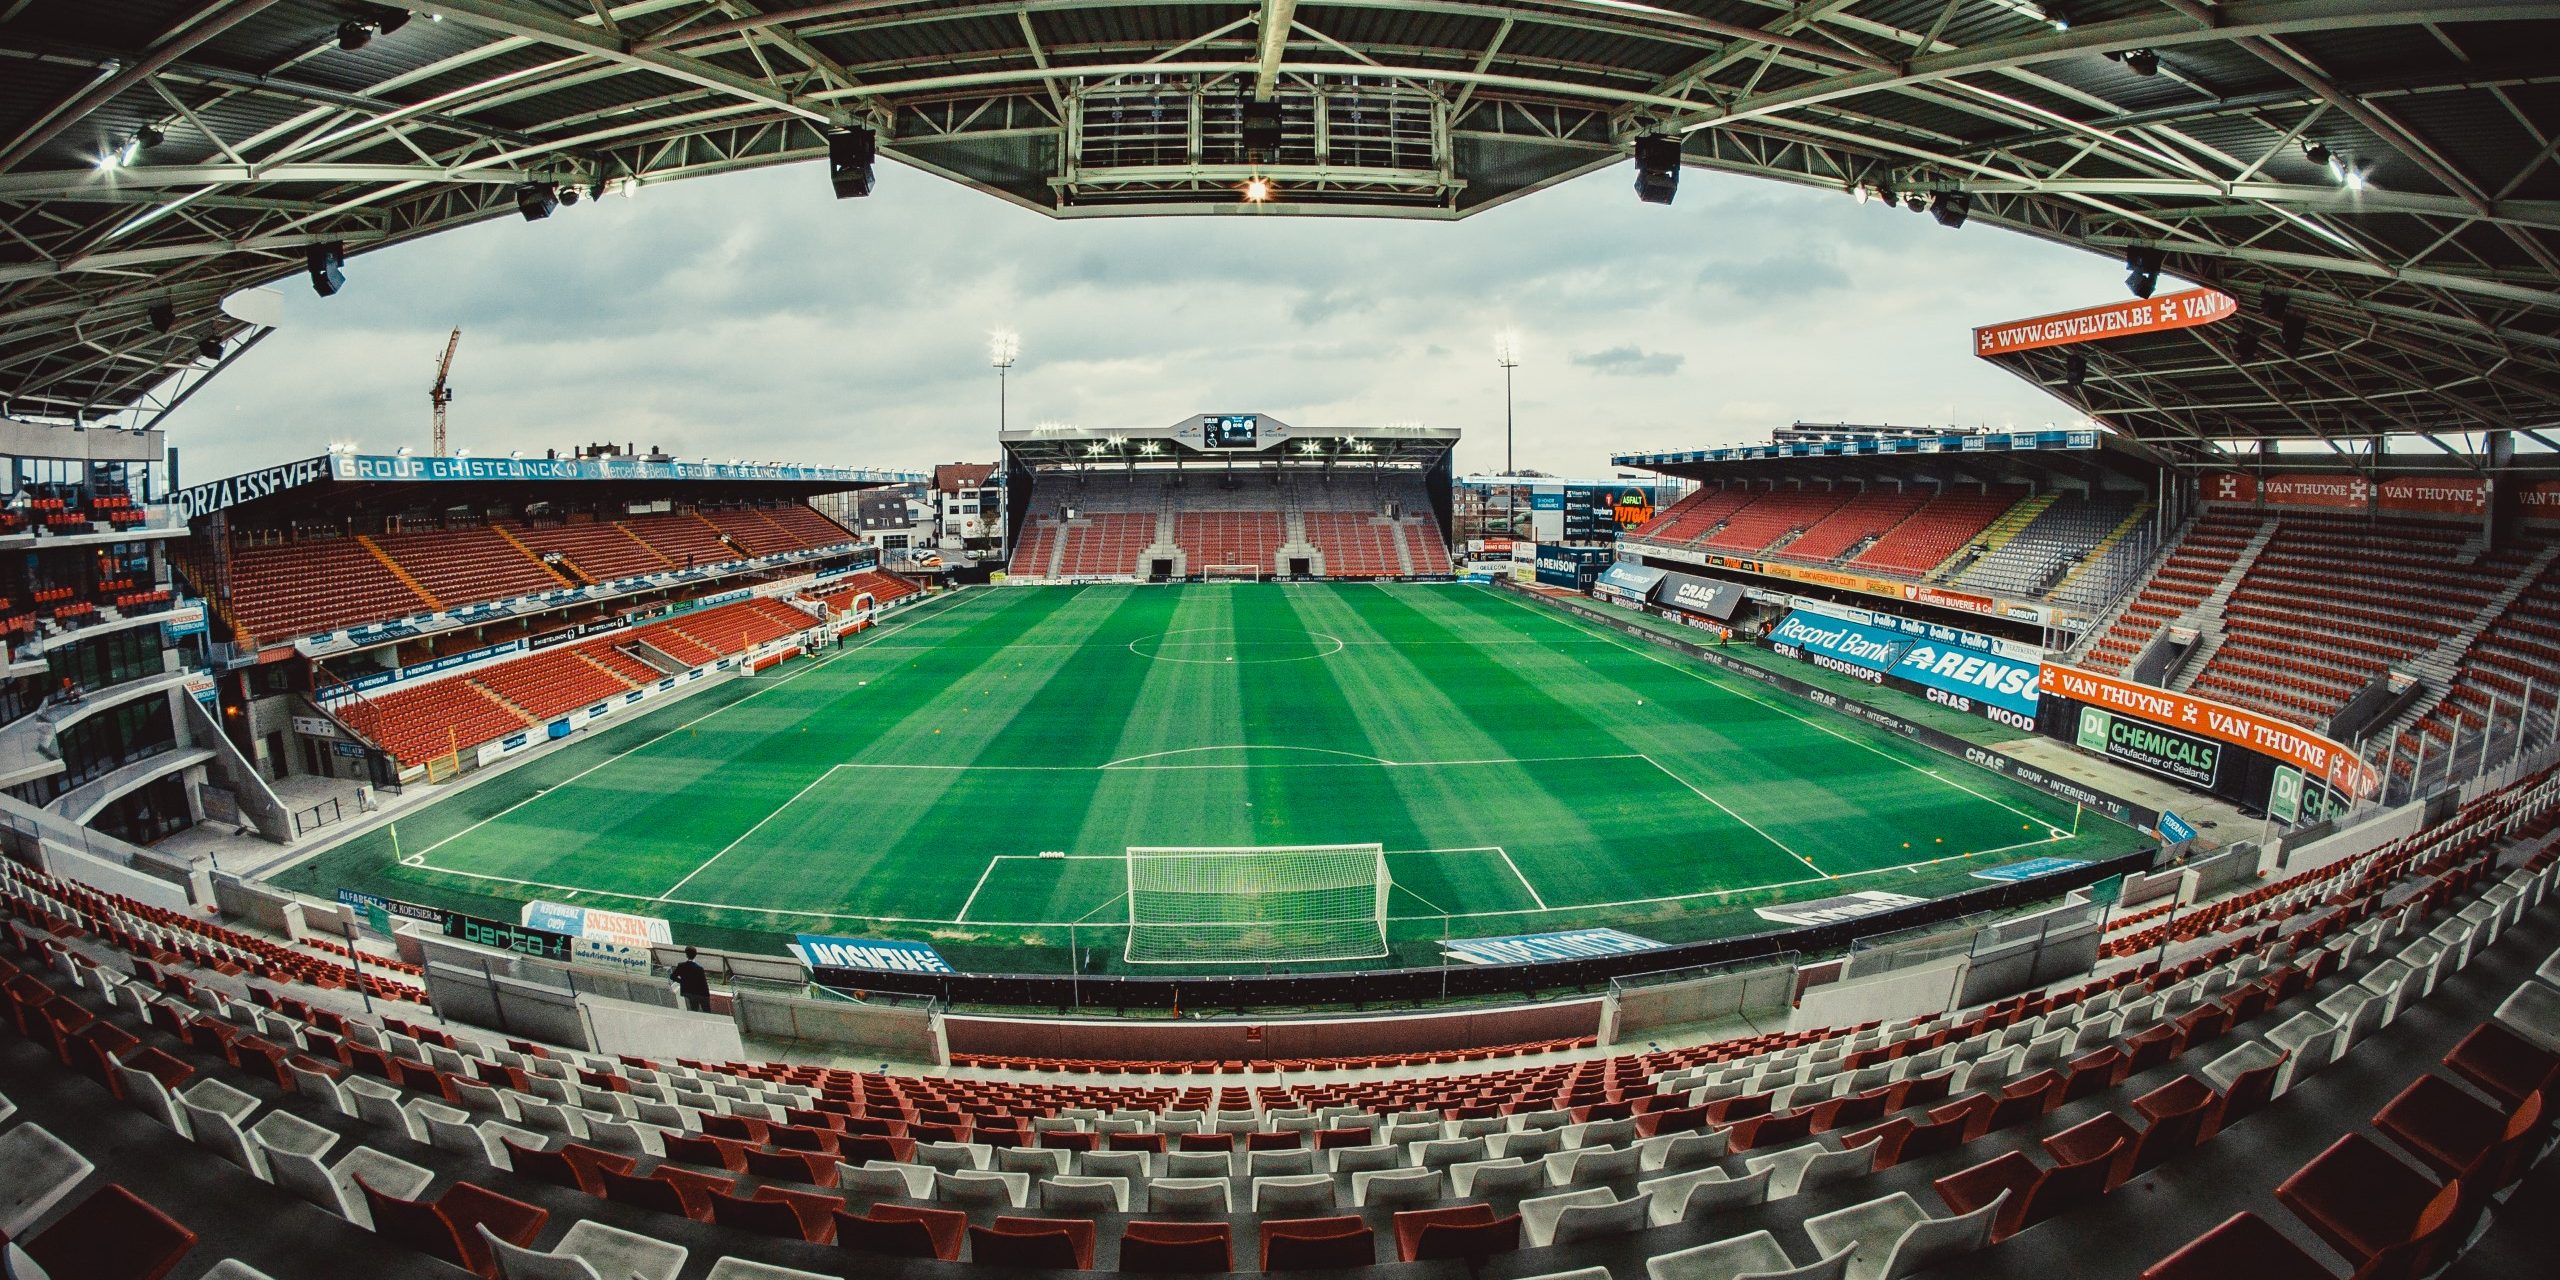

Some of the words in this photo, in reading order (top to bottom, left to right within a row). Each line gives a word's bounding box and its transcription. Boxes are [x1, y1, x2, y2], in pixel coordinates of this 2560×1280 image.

[2183, 293, 2215, 318] VAN
[1997, 306, 2153, 347] WWW.GEWELVEN.BE
[1964, 439, 1982, 448] BASE
[2014, 437, 2034, 446] BASE
[2068, 435, 2091, 445] BASE
[339, 458, 424, 477] GROUP
[432, 460, 564, 478] GHISTELINCK
[600, 462, 670, 479] Mercedes-Benz
[678, 466, 716, 478] GROUP
[720, 468, 782, 479] GHISTELINCK
[2266, 483, 2293, 494] VAN
[2294, 484, 2347, 496] THUYNE
[2385, 486, 2413, 498] VAN
[2416, 488, 2473, 501] THUYNE
[168, 480, 233, 521] FORZA
[1622, 496, 1642, 505] ASFALT
[1614, 506, 1654, 523] TUTGAT
[1543, 557, 1577, 573] RENSON
[1592, 590, 1607, 602] CRAS
[1612, 596, 1644, 612] WOODSHOPS
[1678, 583, 1715, 601] CRAS
[1674, 595, 1709, 610] WOODSHOPS
[1946, 598, 1975, 611] BUVERIE
[1982, 604, 1992, 614] Co
[462, 612, 491, 624] Record
[2007, 607, 2038, 622] BOSSUYT
[1662, 610, 1682, 624] CRAS
[1688, 618, 1733, 639] WOODSHOS
[353, 631, 391, 646] Record
[393, 625, 418, 639] Bank
[534, 633, 567, 646] GHISTELINCK
[1778, 618, 1848, 648] Record
[1838, 632, 1890, 662] Bank
[442, 656, 464, 667] RENSON
[1704, 652, 1722, 665] CRAS
[411, 664, 434, 675] RENSON
[1814, 654, 1882, 684] WOODSHOPS
[363, 676, 389, 686] RENSON
[2062, 674, 2097, 697] VAN
[2100, 684, 2174, 718] THUYNE
[1845, 703, 1861, 714] BOUW
[1926, 688, 1970, 712] CRAS
[1988, 706, 2035, 732] WOOD
[2084, 714, 2106, 738] DL
[2112, 722, 2213, 770] CHEMICALS
[2208, 710, 2250, 739] VAN
[2254, 725, 2326, 768] THUYNE
[2109, 742, 2162, 767] Manufacturer
[2163, 760, 2174, 769] of
[2174, 762, 2210, 782] Sealants
[1966, 748, 2005, 770] CRAS
[2016, 768, 2042, 783] BOUW
[2050, 780, 2097, 805] INTERIEUR
[2163, 814, 2188, 837] FEDERALE
[388, 903, 398, 913] DE
[399, 904, 442, 922] KOETSIER.be
[586, 912, 648, 937] NAESSENS
[464, 916, 544, 956] berto
[810, 942, 924, 972] RENSON
